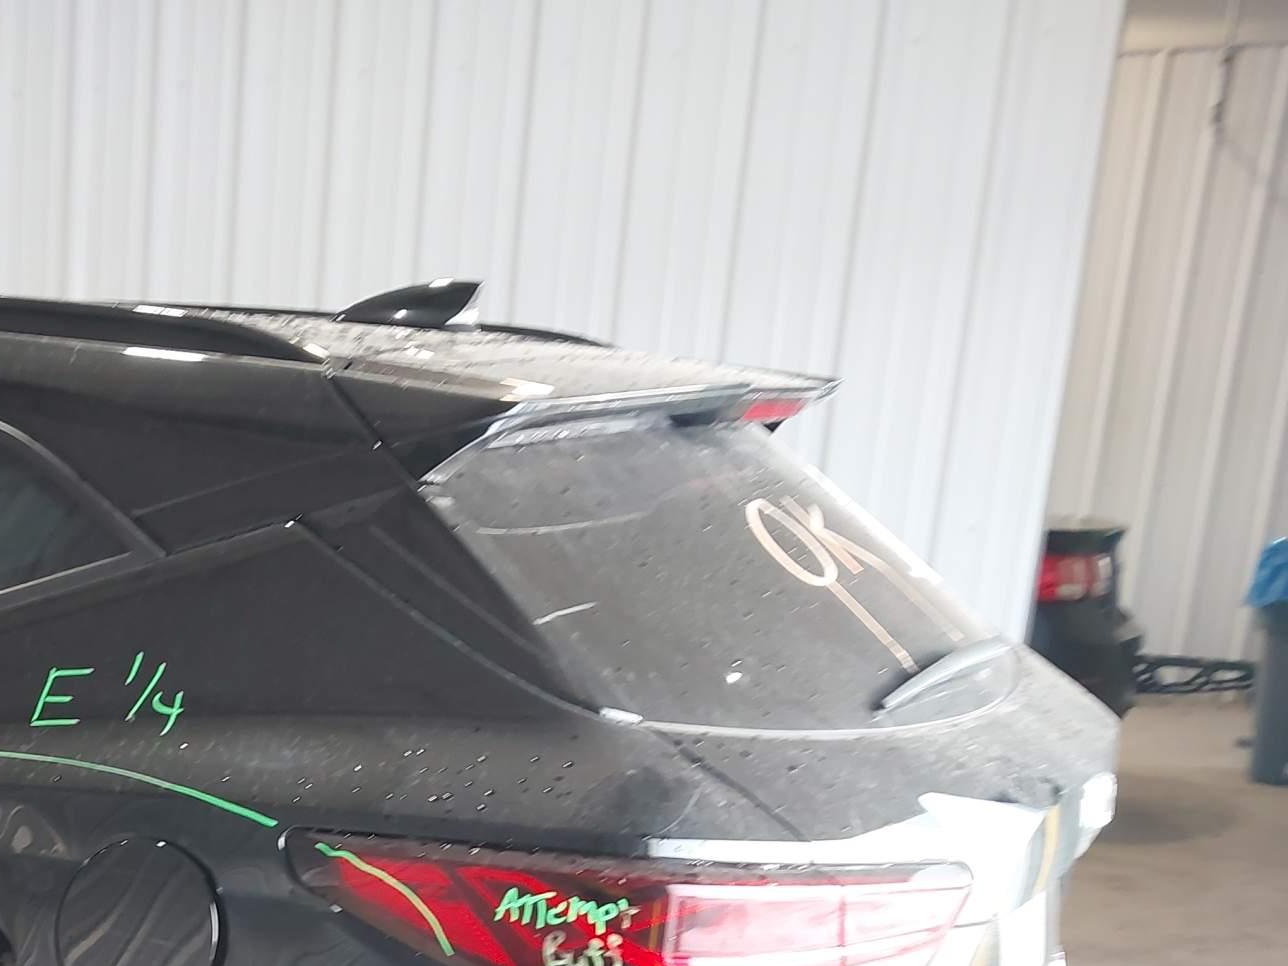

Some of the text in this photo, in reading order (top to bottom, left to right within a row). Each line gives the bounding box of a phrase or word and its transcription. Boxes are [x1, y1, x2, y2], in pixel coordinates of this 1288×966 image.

[745, 497, 964, 642] OK
[30, 651, 185, 736] E 1/4
